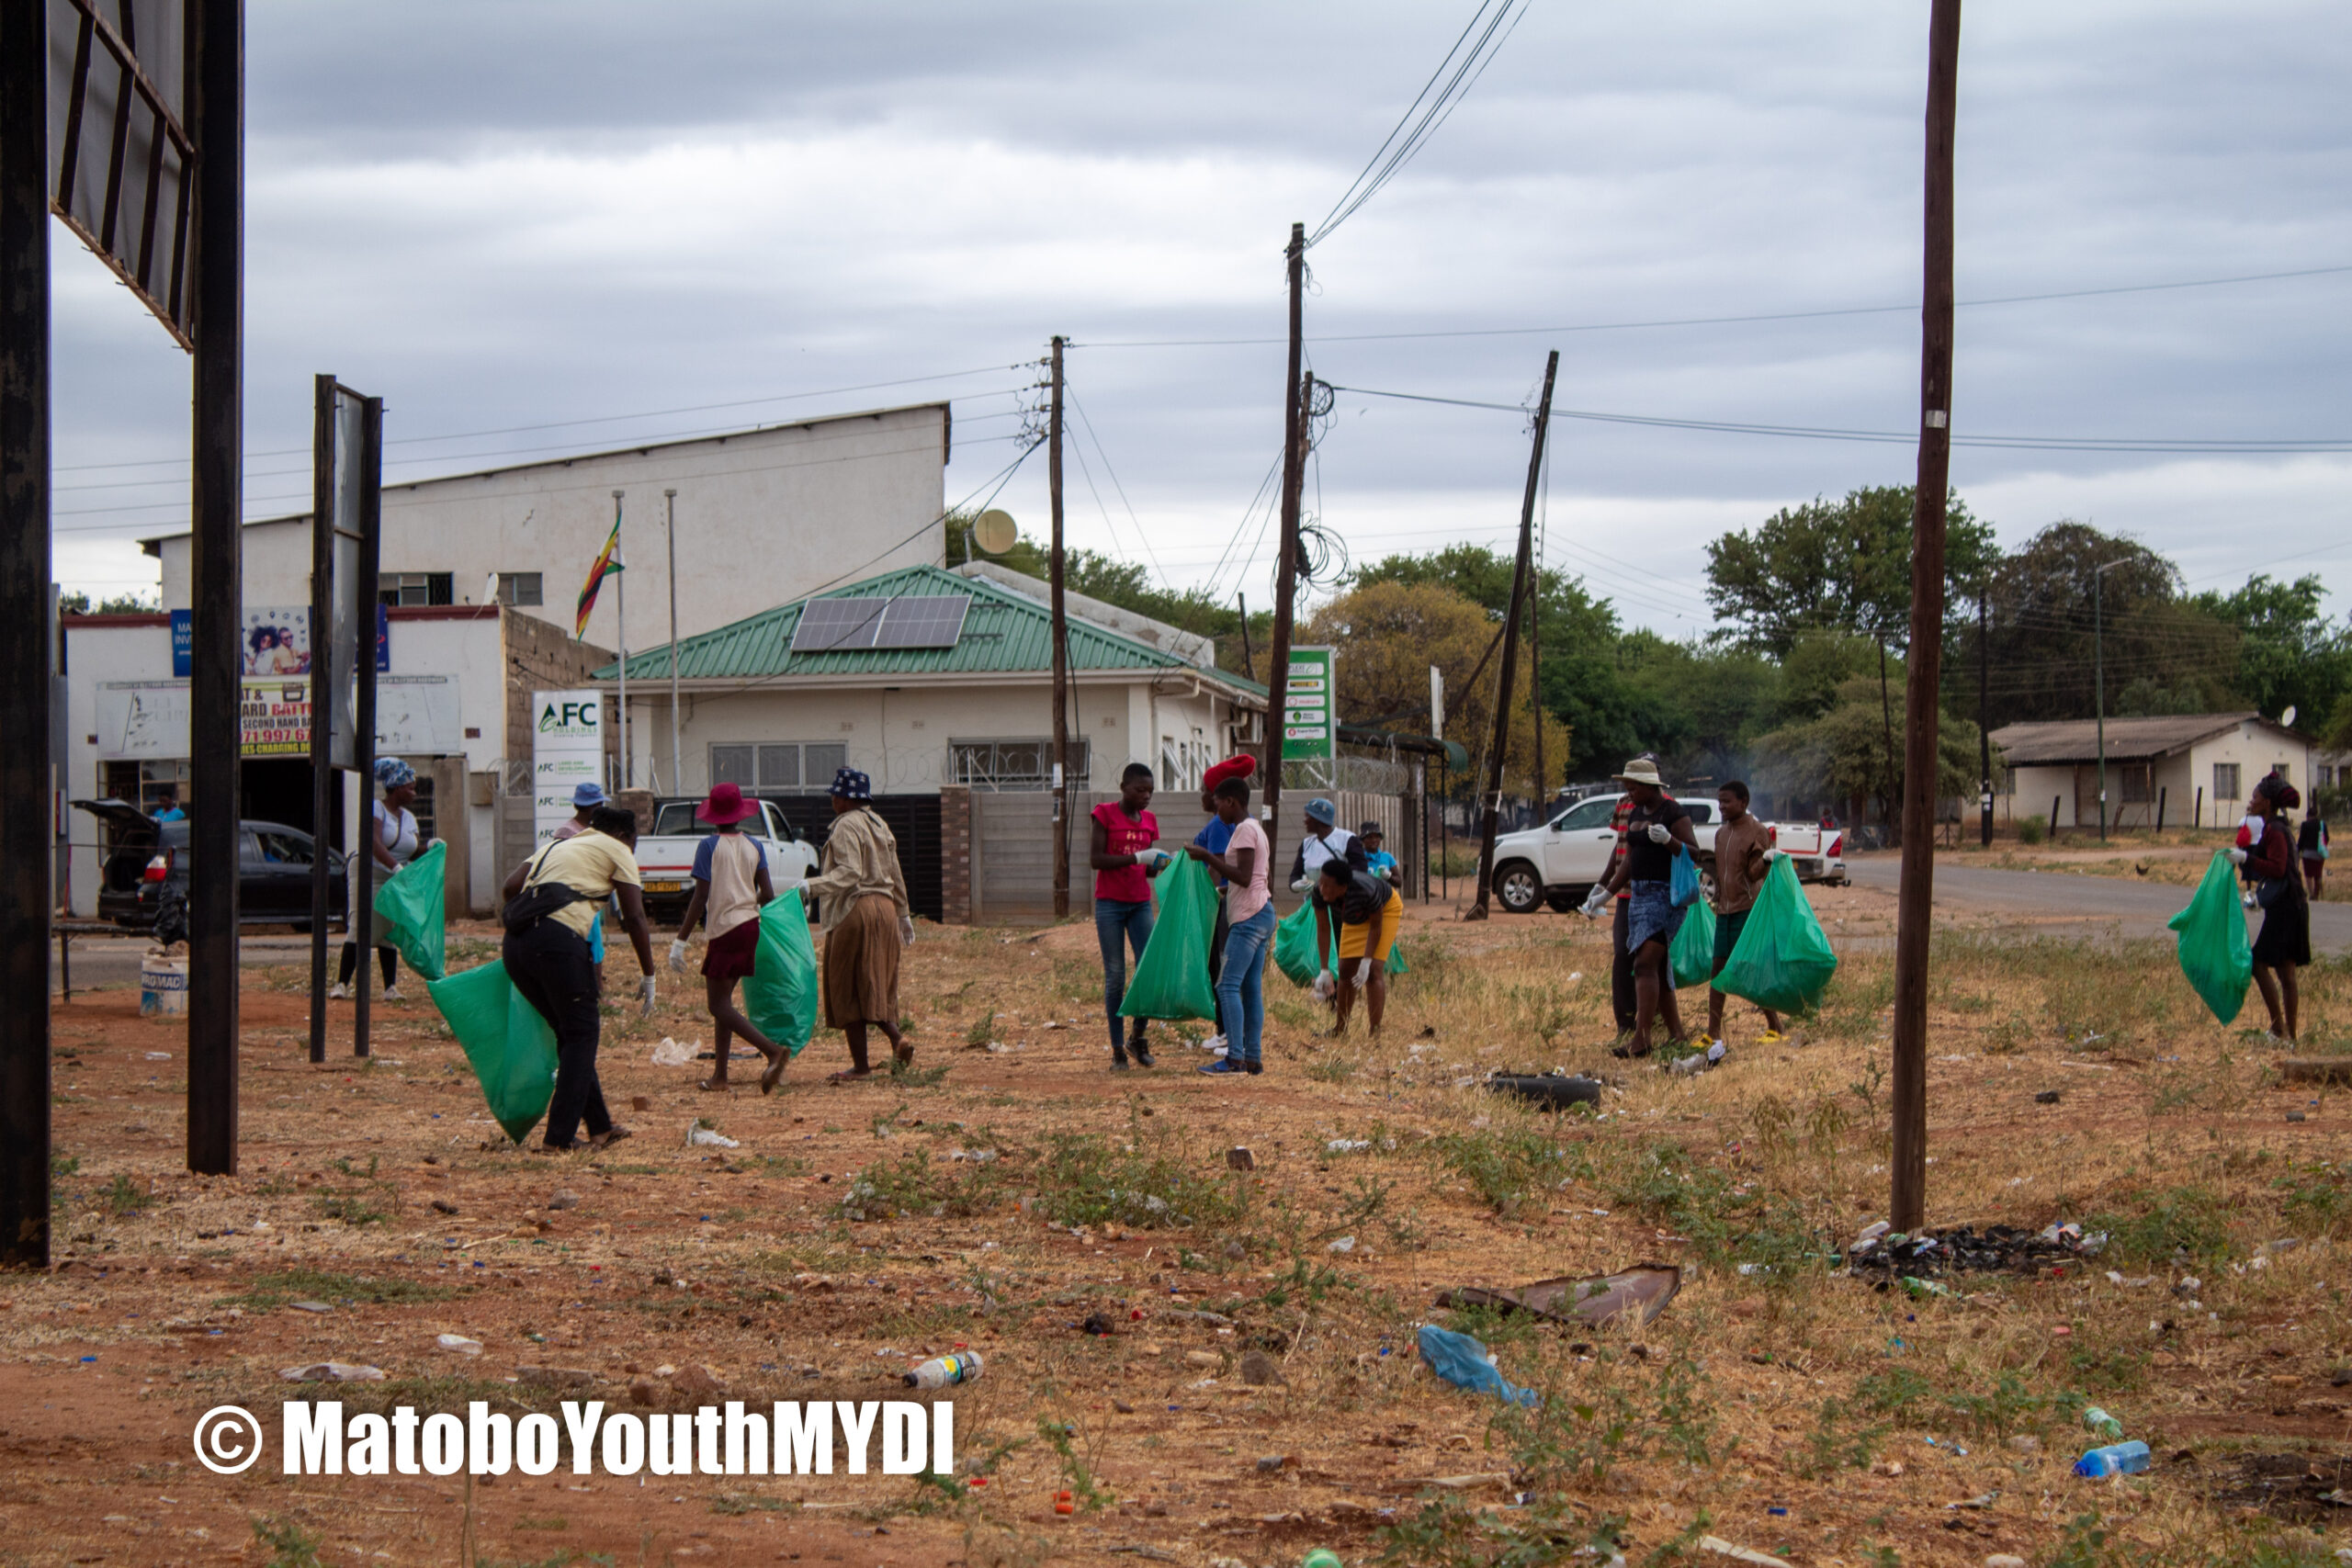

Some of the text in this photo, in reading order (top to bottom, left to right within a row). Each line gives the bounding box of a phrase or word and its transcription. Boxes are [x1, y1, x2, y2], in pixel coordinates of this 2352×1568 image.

[177, 623, 191, 633] MA
[175, 635, 191, 645] INV
[254, 689, 264, 701] &
[242, 703, 267, 716] ARD
[538, 702, 597, 728] AFC
[243, 716, 311, 729] SECOND HAND BA
[241, 728, 311, 743] 71 997 67
[537, 762, 554, 773] AFC
[537, 796, 554, 807] AFC
[538, 829, 555, 840] AFC
